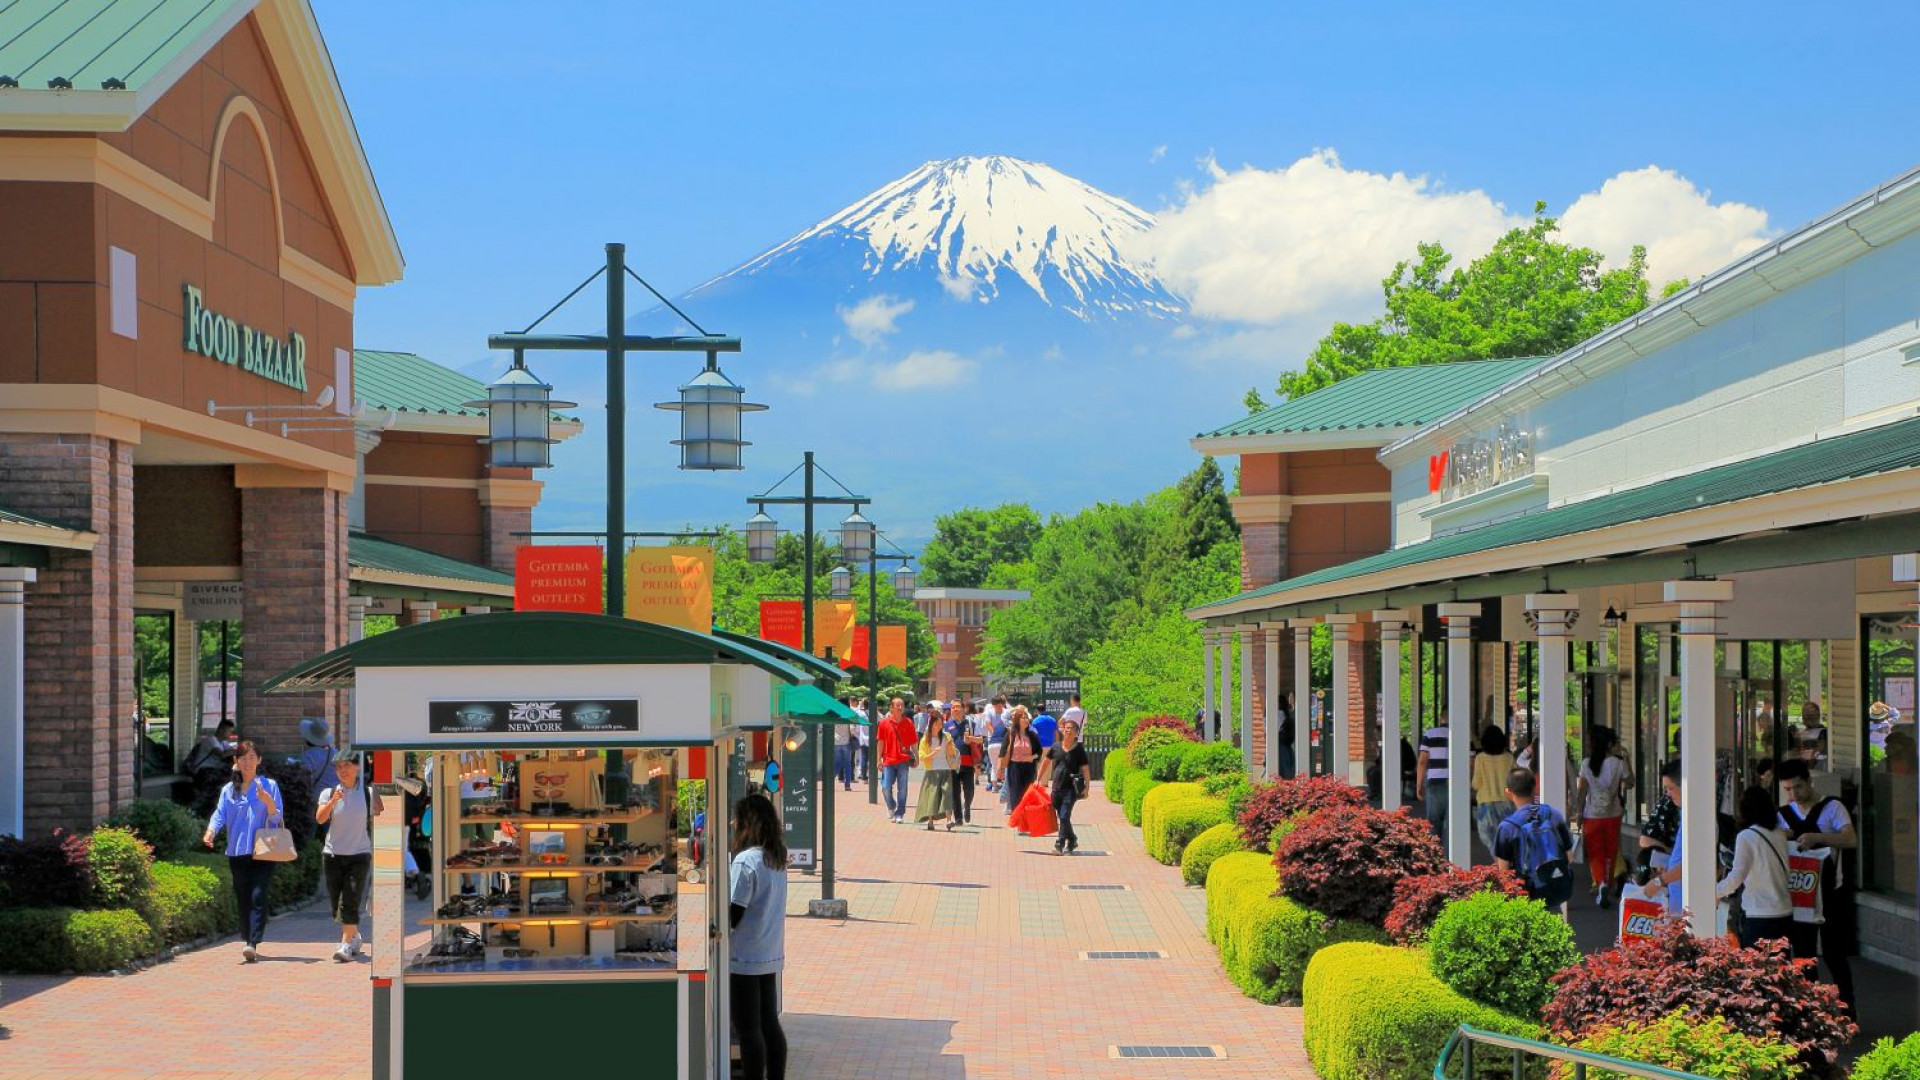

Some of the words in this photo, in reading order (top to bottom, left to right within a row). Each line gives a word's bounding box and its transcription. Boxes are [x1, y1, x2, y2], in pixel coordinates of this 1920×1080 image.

[184, 283, 239, 365] FOOD
[243, 324, 308, 392] BAZAAR
[529, 560, 590, 573] GOTEMBA
[640, 562, 701, 575] GOTEMBA
[531, 577, 587, 588] PREMIUM
[642, 579, 698, 590] PREMIUM
[532, 594, 586, 605] OUTLETS
[507, 722, 532, 732] NEW
[533, 722, 563, 732] YORK
[1787, 871, 1817, 893] EGO
